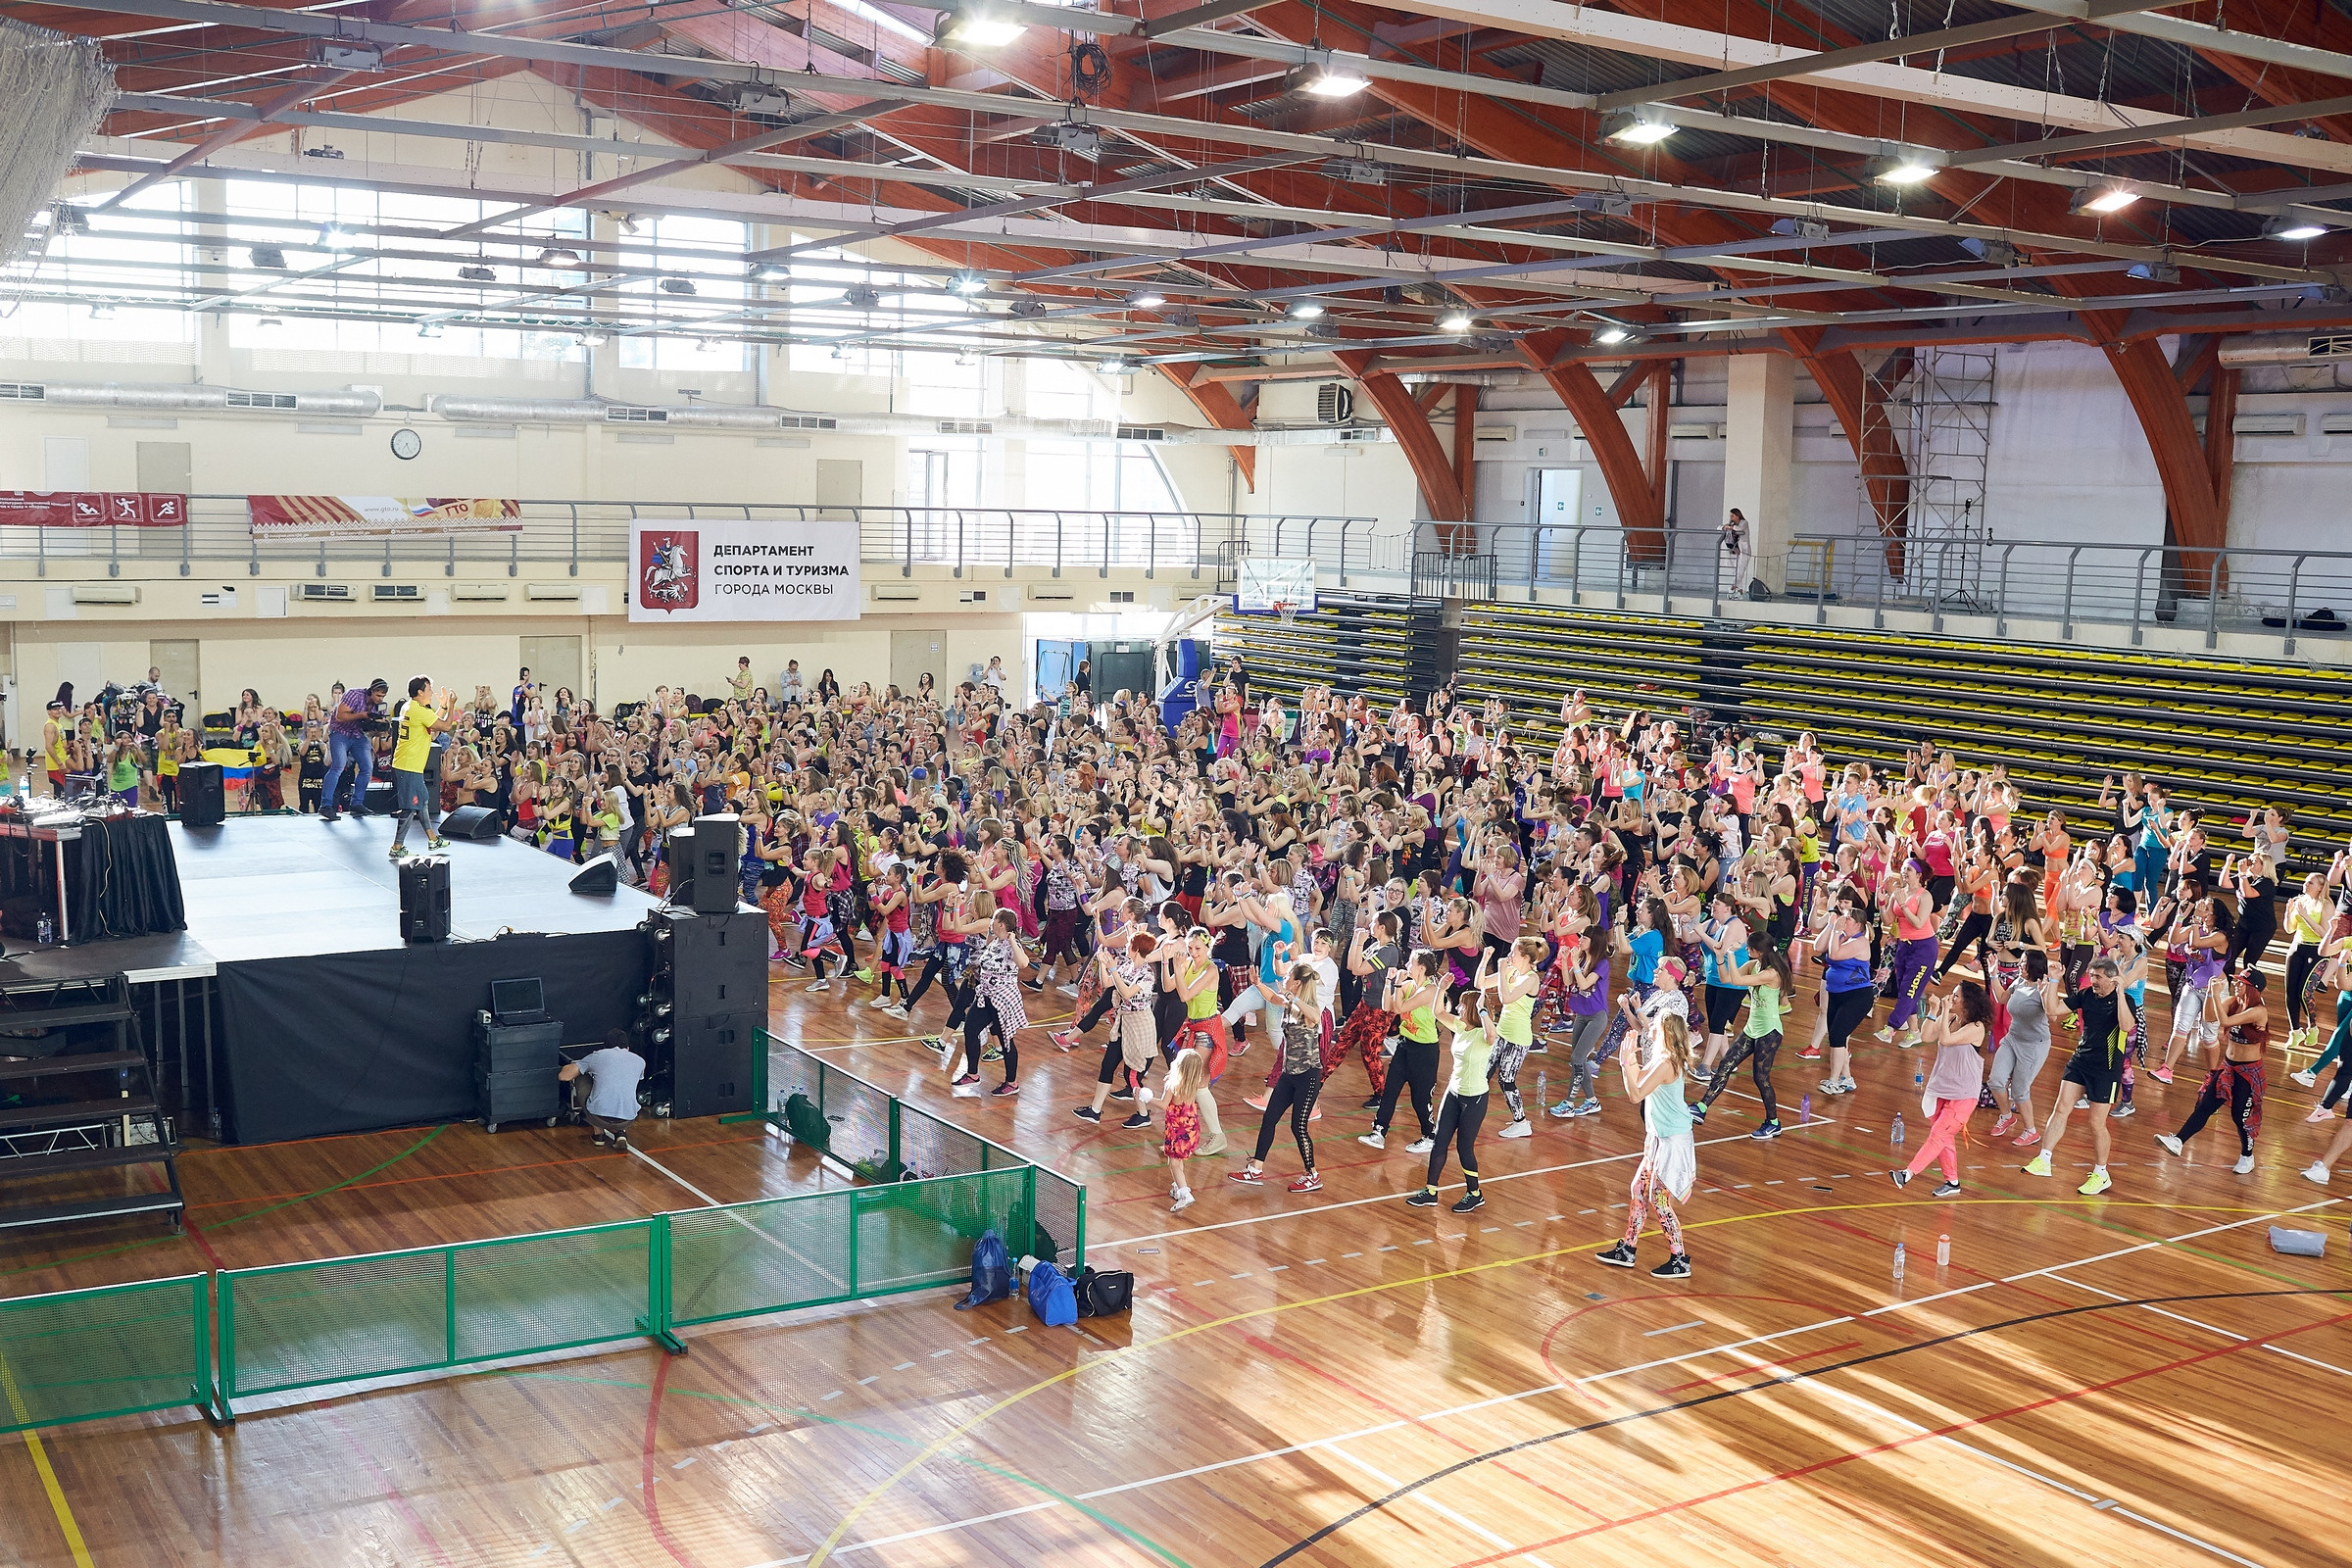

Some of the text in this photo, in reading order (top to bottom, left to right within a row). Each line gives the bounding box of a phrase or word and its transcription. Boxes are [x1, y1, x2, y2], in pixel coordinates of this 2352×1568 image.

[444, 503, 468, 517] ГТО
[713, 545, 814, 557] ДЕПАРТАМЕНТ
[714, 565, 849, 576] СПОРТА И ТУРИЗМА
[715, 584, 833, 596] ГОРОДА МОСКВЫ
[1907, 965, 1927, 999] PROFIT
